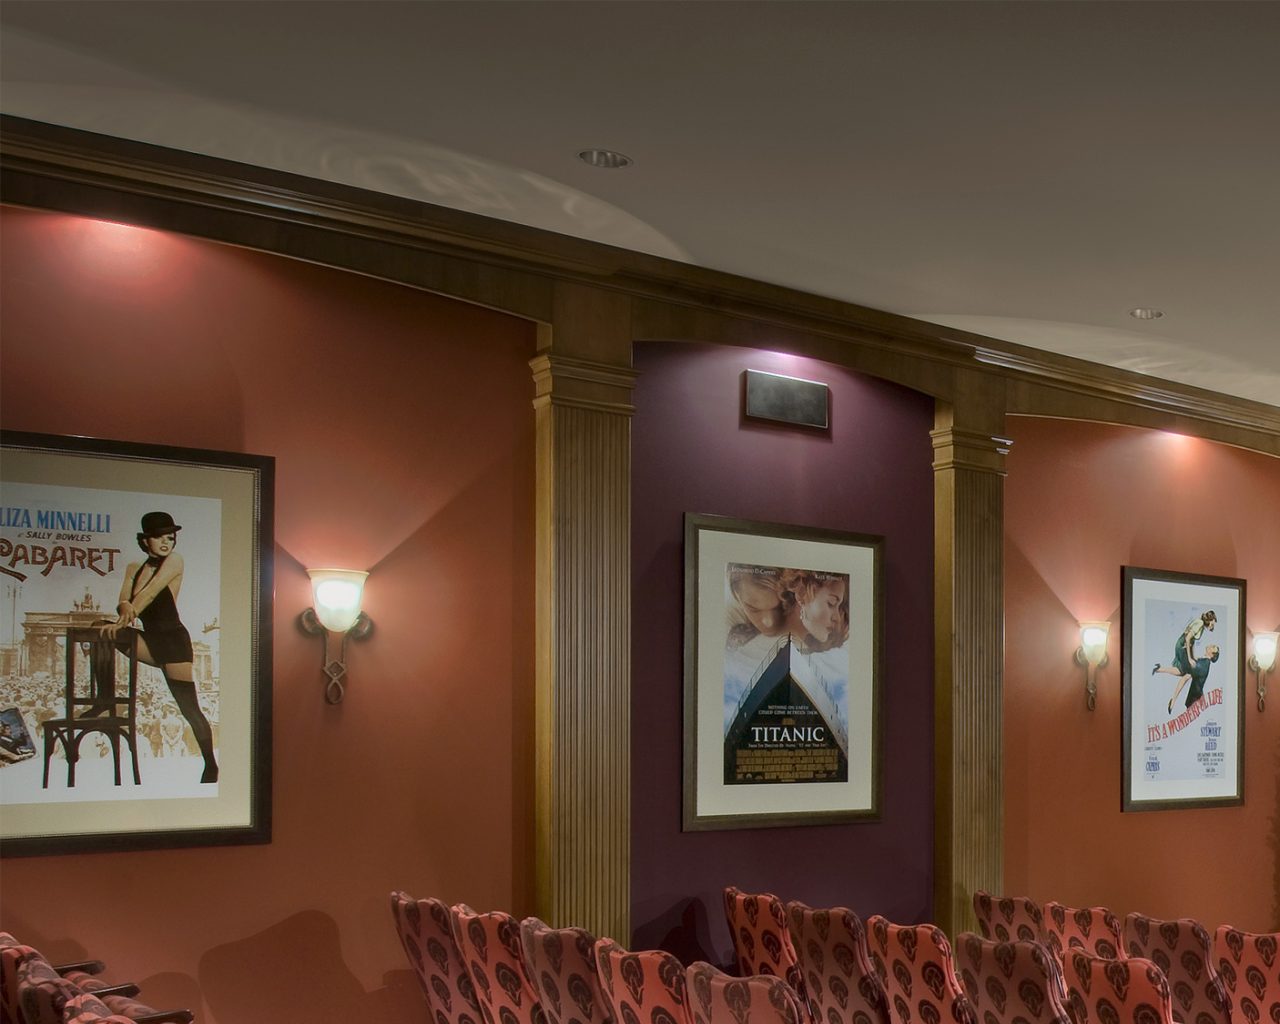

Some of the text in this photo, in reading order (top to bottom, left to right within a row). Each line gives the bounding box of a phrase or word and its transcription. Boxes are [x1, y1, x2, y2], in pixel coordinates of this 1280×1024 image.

[37, 510, 112, 533] MINNELLI
[25, 531, 53, 540] SALLY
[55, 533, 93, 542] BOWLES
[1162, 722, 1168, 739] A
[1167, 695, 1208, 736] WONDERFUL
[1207, 688, 1223, 706] LIFE
[751, 726, 825, 742] TITANIC
